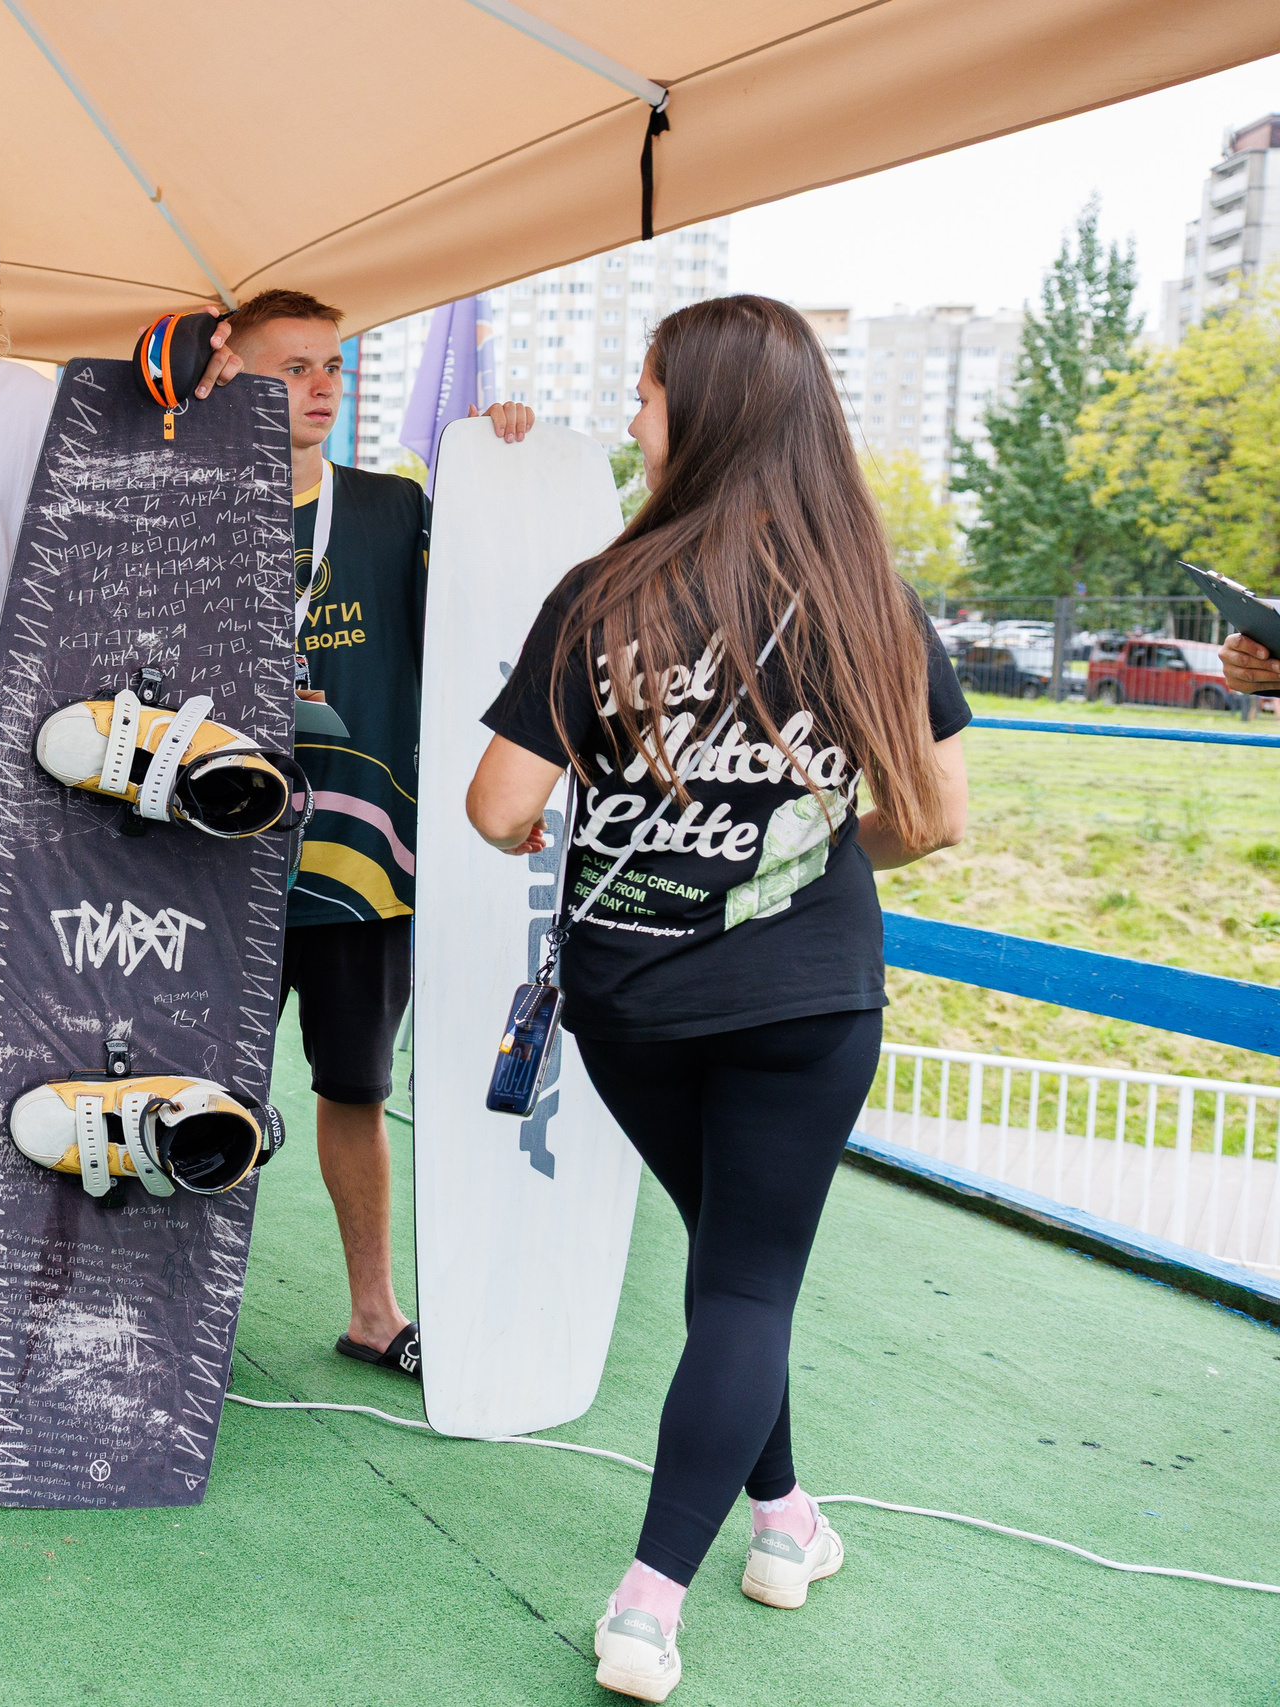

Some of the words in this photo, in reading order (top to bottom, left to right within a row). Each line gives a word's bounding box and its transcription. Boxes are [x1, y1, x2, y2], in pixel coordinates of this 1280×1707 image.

[144, 495, 159, 512] И
[216, 510, 251, 524] МЫ
[93, 567, 108, 582] И
[174, 576, 221, 598] НАМ
[217, 619, 252, 632] МЫ
[305, 628, 366, 651] воде
[191, 665, 222, 682] ИЗ
[596, 710, 850, 787] Matcha
[573, 787, 759, 862] Latte
[612, 881, 646, 902] FROM
[624, 870, 647, 884] AND
[647, 875, 710, 902] CREAMY
[399, 1332, 419, 1373] EC
[761, 1537, 790, 1552] adidas
[624, 1618, 656, 1635] adidas
